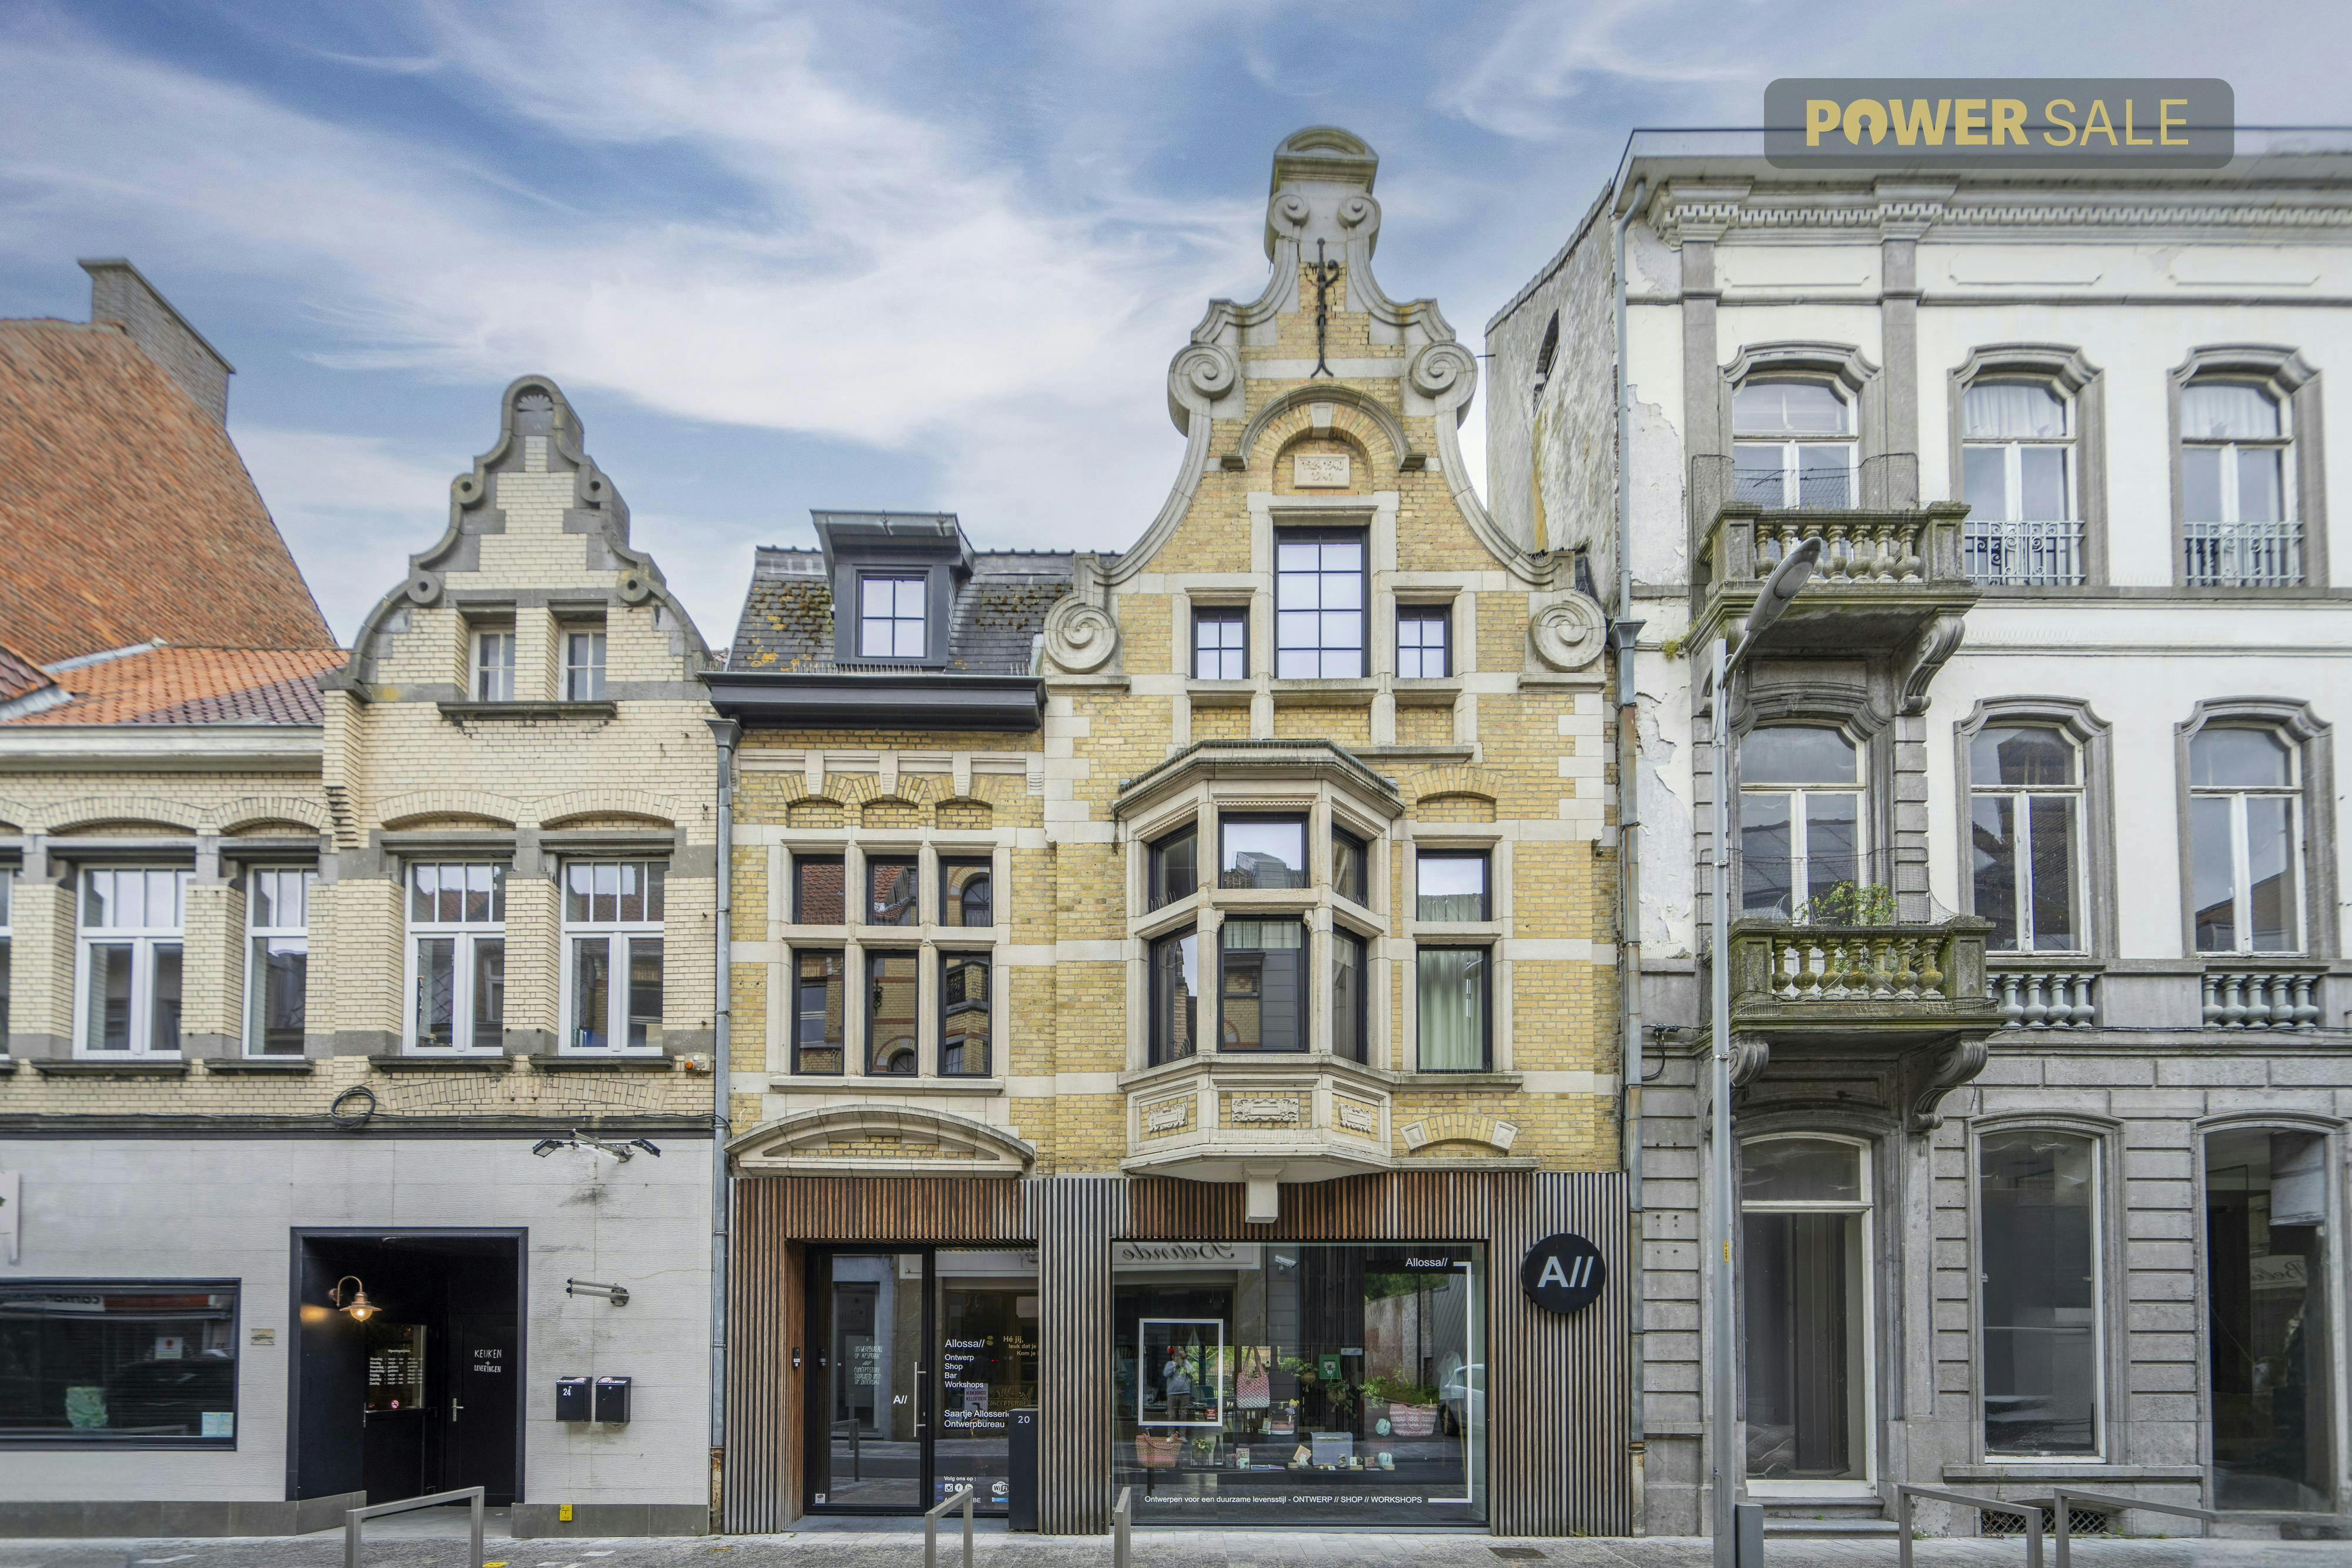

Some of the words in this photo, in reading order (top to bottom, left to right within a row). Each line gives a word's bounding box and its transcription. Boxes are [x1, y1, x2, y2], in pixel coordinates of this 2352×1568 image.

[1405, 1258, 1448, 1267] Allossa//
[1537, 1256, 1594, 1288] A//
[944, 1339, 985, 1348] Allossa//
[1015, 1336, 1024, 1344] jij,
[475, 1349, 502, 1358] KEUKEN
[944, 1354, 974, 1362] Ontwerp
[474, 1365, 502, 1373] LEVERINGEN
[944, 1381, 984, 1389] Workshops
[563, 1388, 571, 1396] 24
[893, 1395, 908, 1404] A//
[944, 1410, 972, 1419] Saartje
[944, 1420, 1005, 1429] Ontwerpbureau
